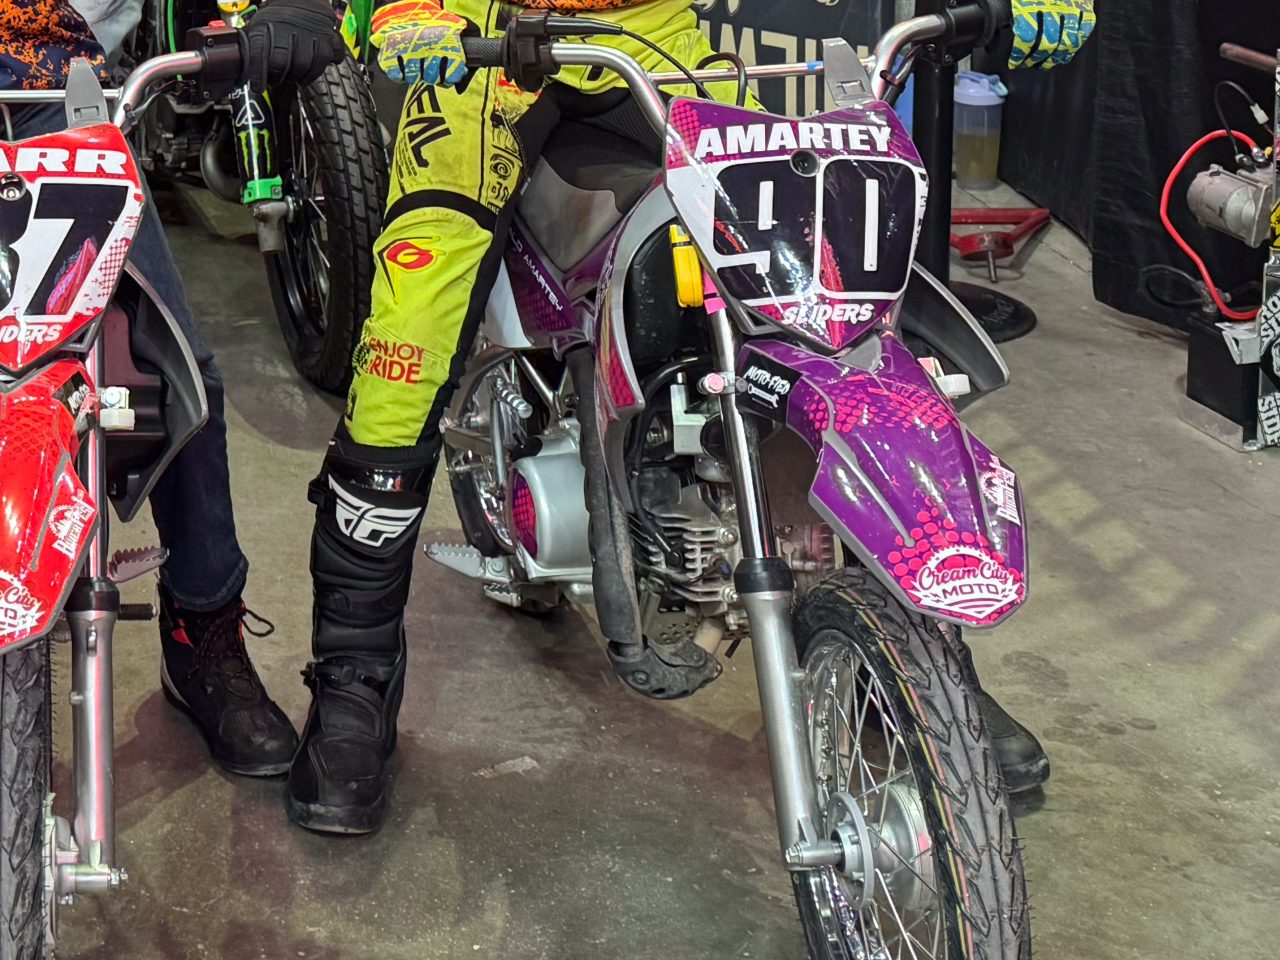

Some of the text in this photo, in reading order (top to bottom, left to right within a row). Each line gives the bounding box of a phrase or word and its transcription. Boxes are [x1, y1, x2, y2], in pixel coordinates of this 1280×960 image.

[695, 122, 892, 158] AMARTEY
[781, 303, 875, 325] SLIDERS
[369, 336, 426, 363] ENJOY
[369, 355, 422, 385] RIDE
[920, 562, 1011, 593] Cream City
[941, 583, 1000, 597] MOTO
[4, 586, 37, 610] City
